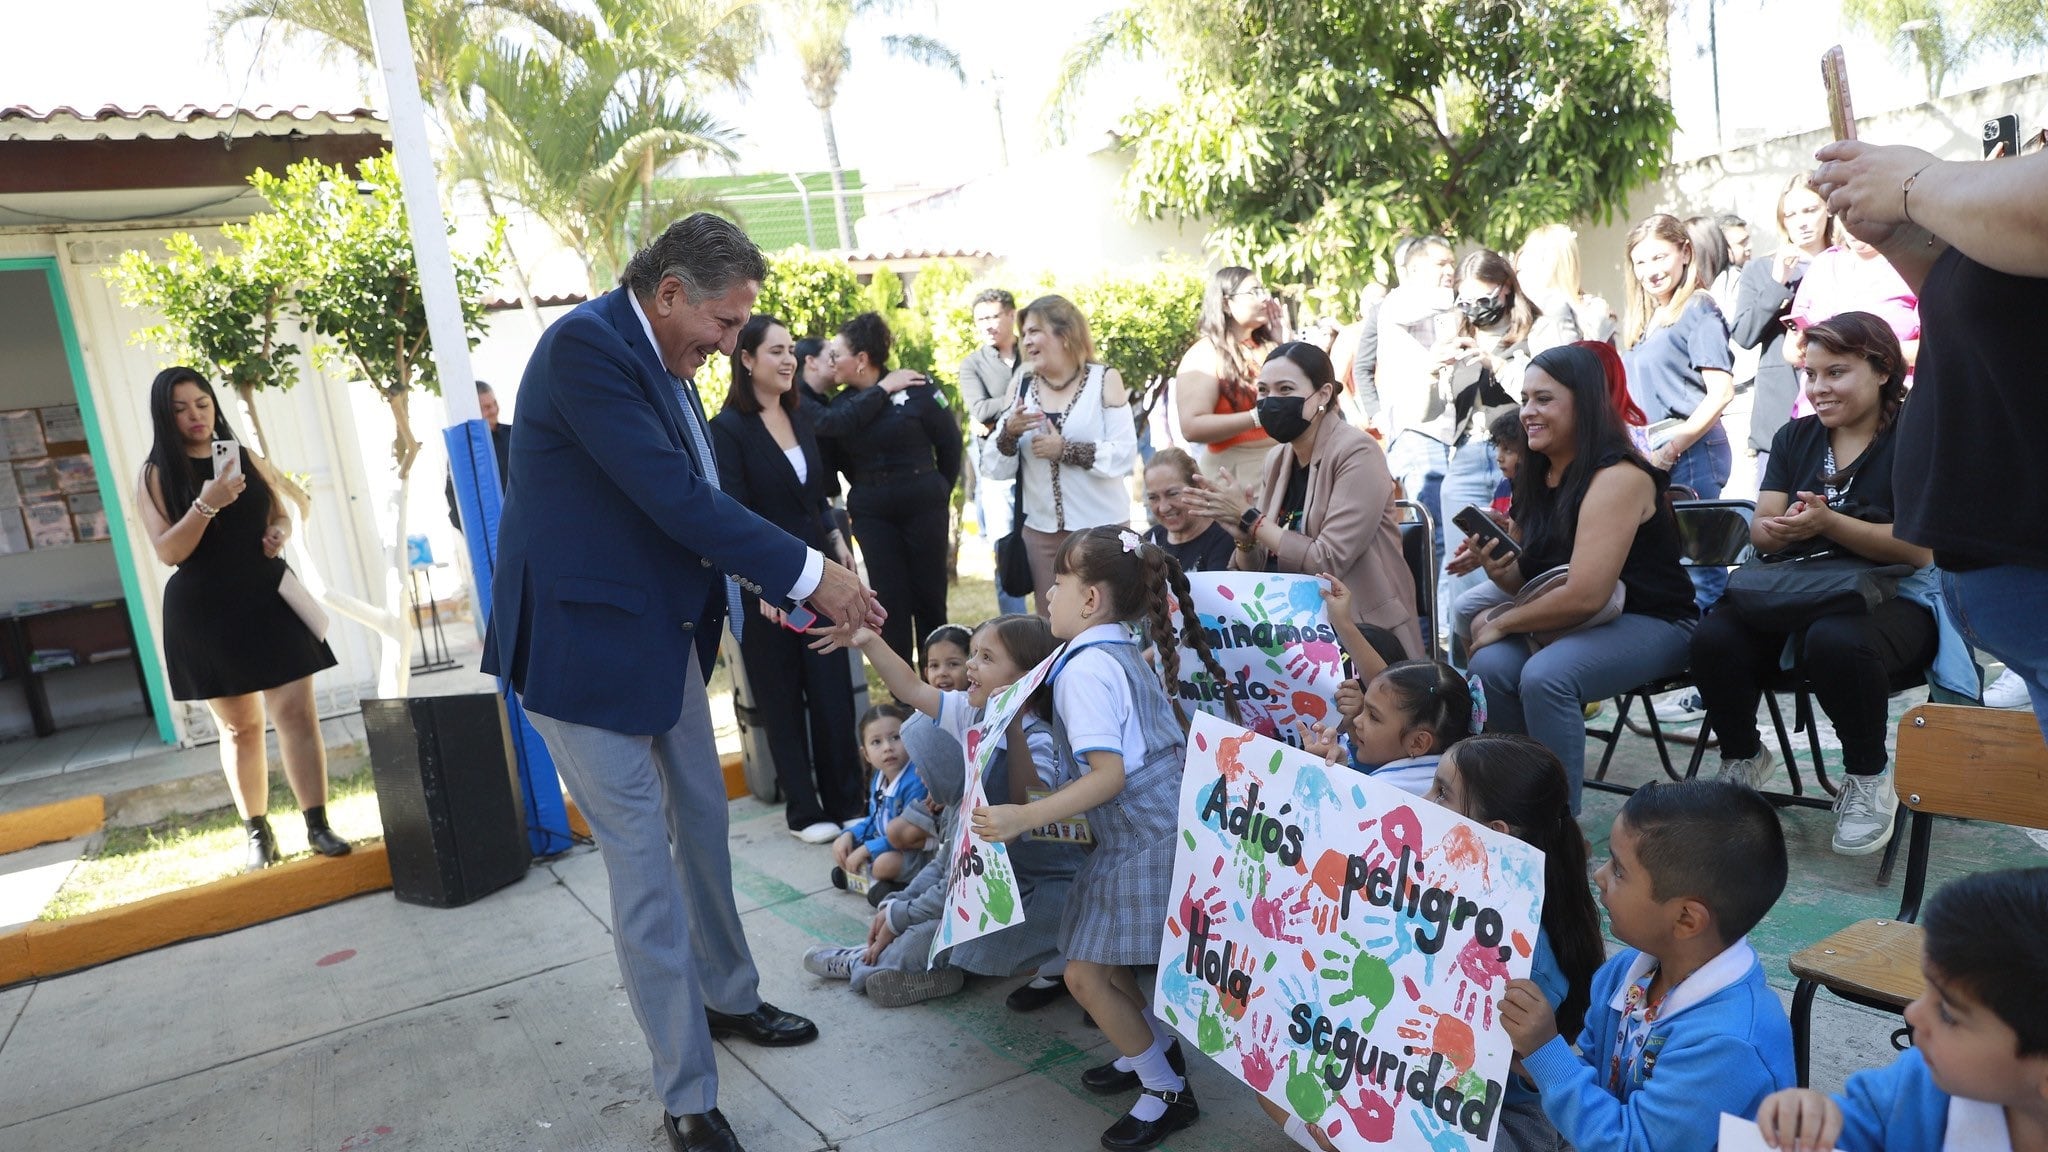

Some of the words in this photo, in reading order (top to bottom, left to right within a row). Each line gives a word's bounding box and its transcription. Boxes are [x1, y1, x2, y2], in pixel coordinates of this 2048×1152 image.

[1202, 774, 1304, 866] Adiós
[1341, 845, 1512, 963] peligro,
[1186, 907, 1252, 1007] Hola
[1288, 1003, 1502, 1142] seguridad
